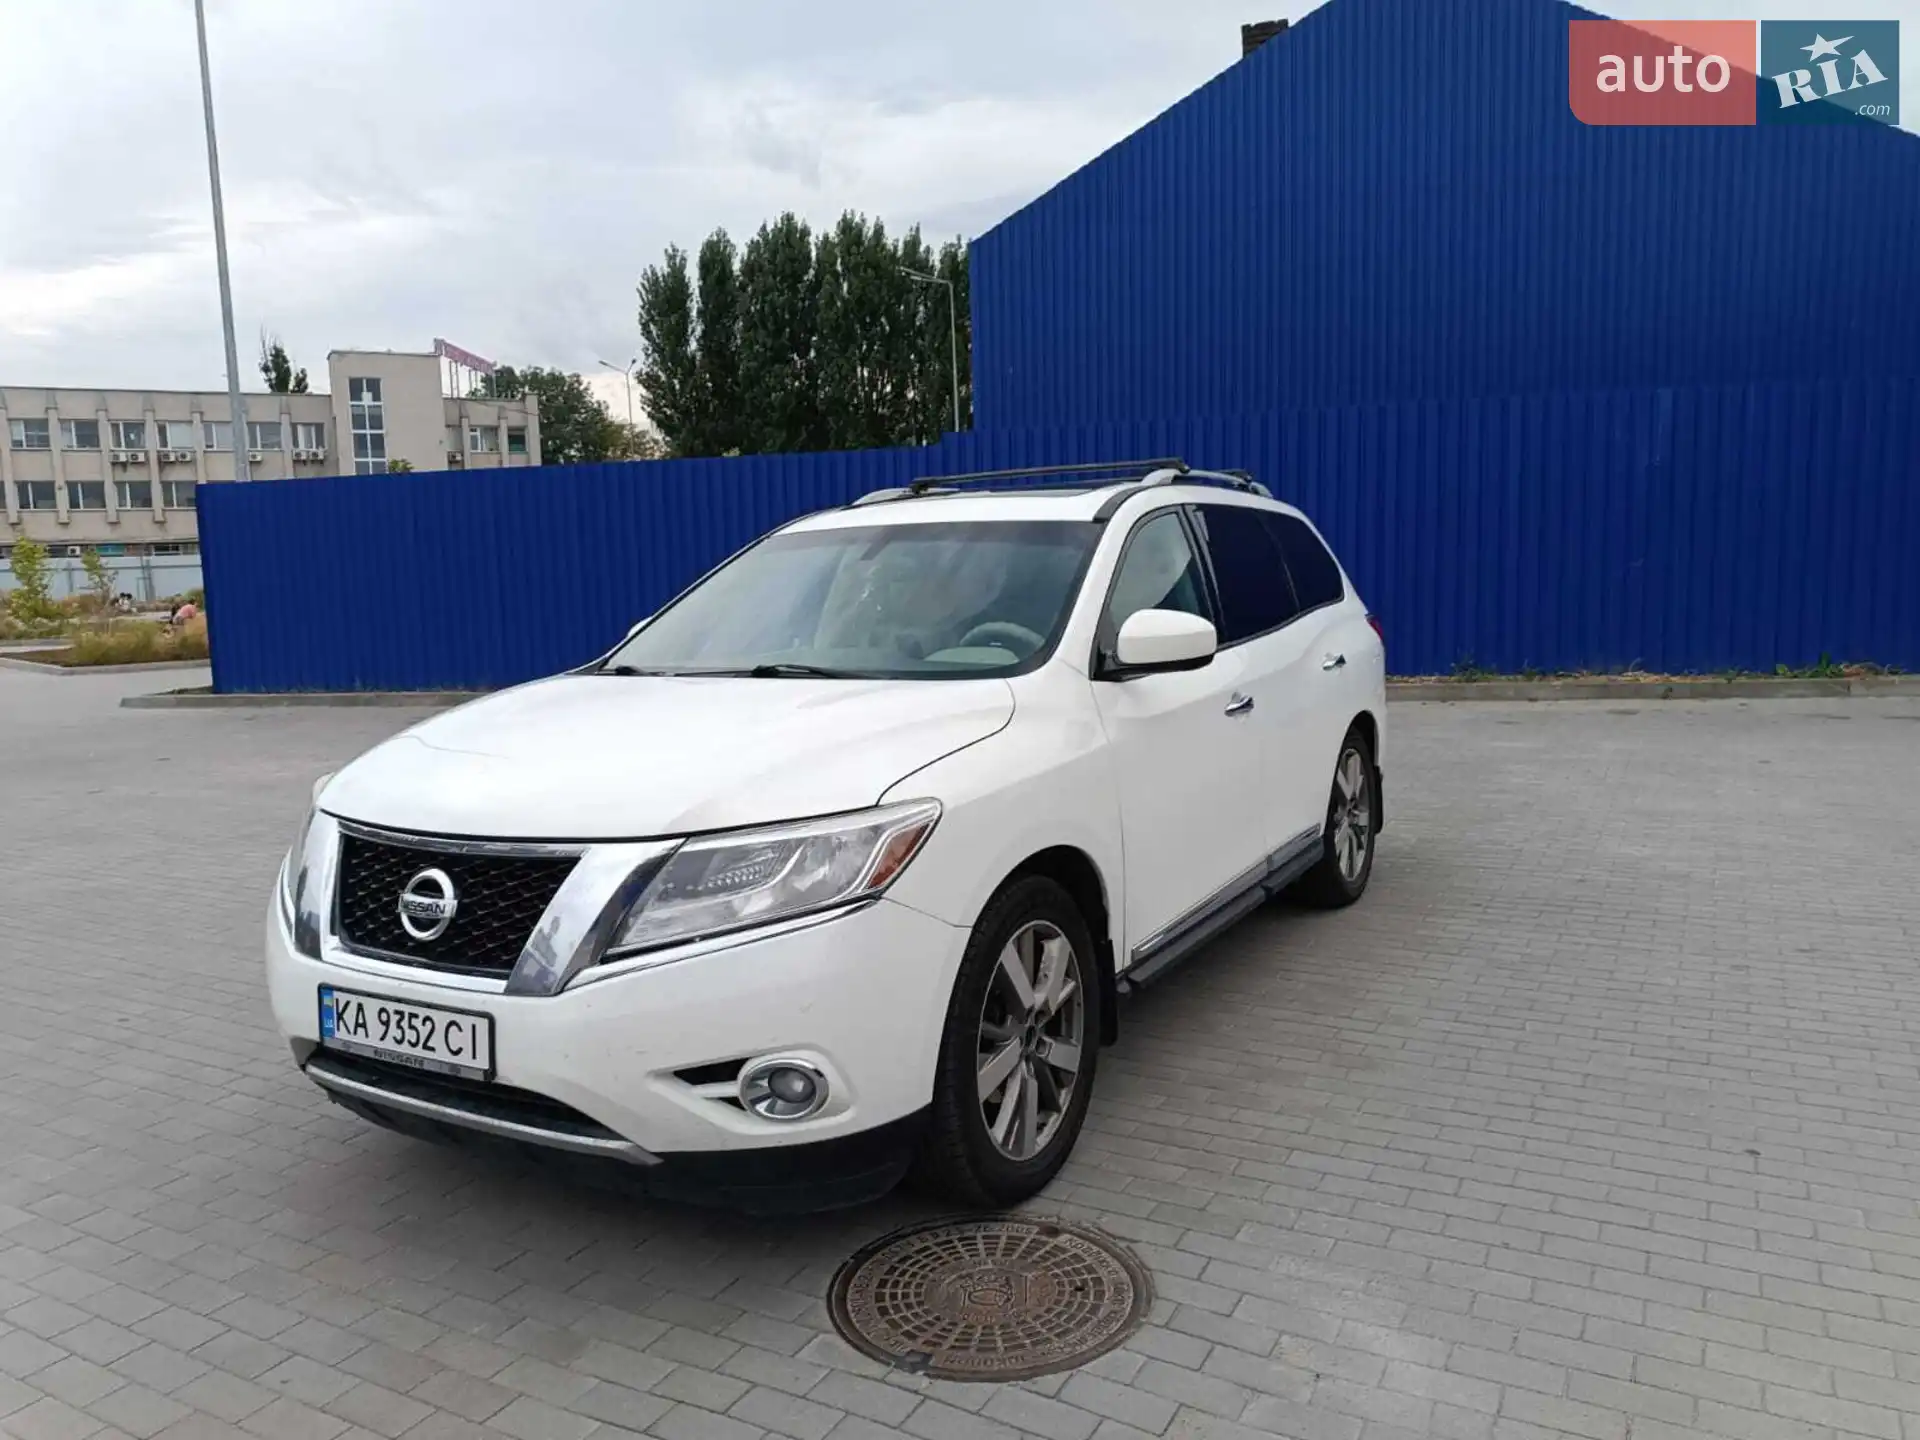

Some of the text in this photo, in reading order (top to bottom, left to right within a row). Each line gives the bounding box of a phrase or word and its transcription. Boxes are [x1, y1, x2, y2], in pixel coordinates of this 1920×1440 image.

[335, 998, 370, 1038] KA
[377, 1007, 437, 1053] 9352
[444, 1019, 477, 1060] CI
